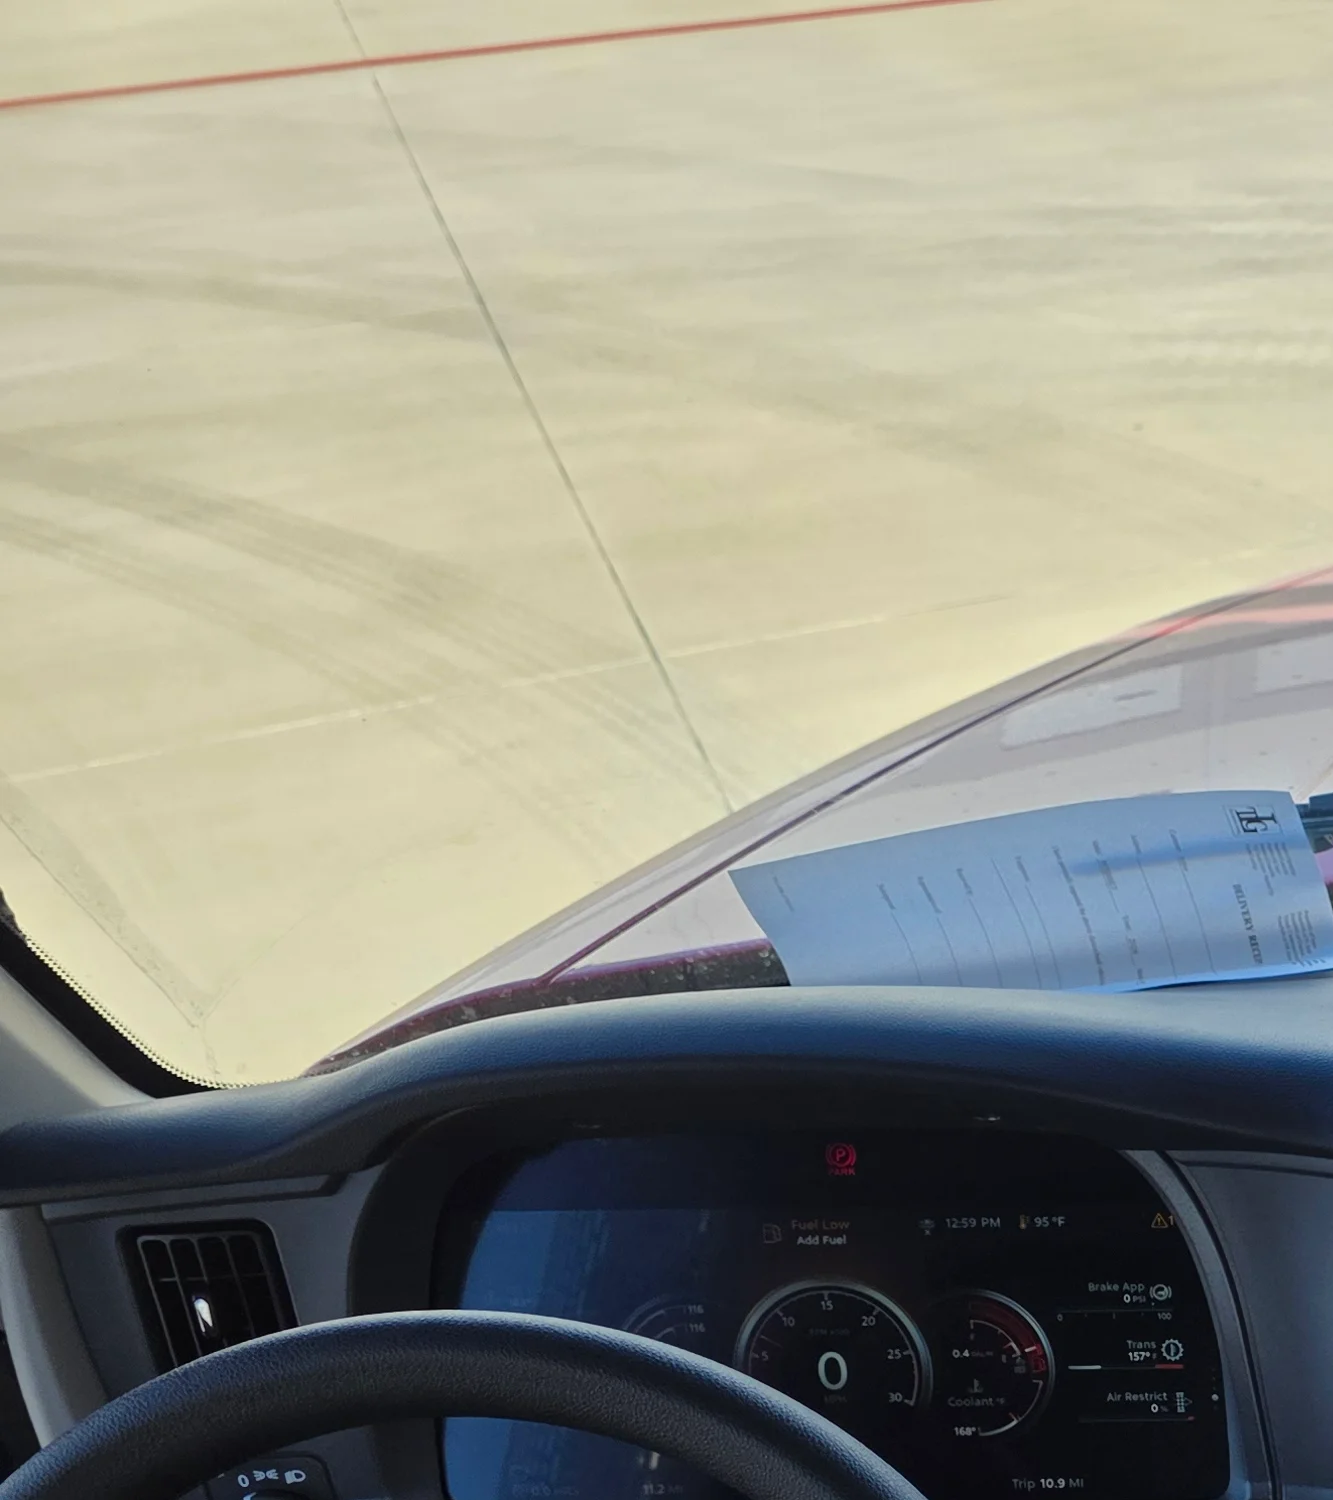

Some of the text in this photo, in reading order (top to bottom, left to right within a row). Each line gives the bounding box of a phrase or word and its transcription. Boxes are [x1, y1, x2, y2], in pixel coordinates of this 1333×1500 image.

[791, 1219, 850, 1231] Fuel Low
[945, 1217, 1001, 1229] 12:59 PM
[1034, 1217, 1049, 1228] 95
[797, 1235, 847, 1246] Add Fuel
[1088, 1282, 1145, 1294] Brake App
[1123, 1293, 1131, 1304] 0
[821, 1301, 834, 1311] 15
[782, 1316, 796, 1327] 10
[861, 1316, 876, 1327] 20
[1157, 1312, 1172, 1321] 100
[1126, 1340, 1157, 1350] Trans
[761, 1351, 769, 1361] 5
[887, 1349, 902, 1360] 25
[952, 1349, 970, 1359] 0.4
[817, 1351, 848, 1391] 0
[888, 1392, 903, 1403] 30
[948, 1397, 994, 1407] Coolant
[1106, 1391, 1168, 1402] Air Restrict
[1150, 1403, 1159, 1413] 0
[1012, 1478, 1036, 1492] Trip
[1040, 1478, 1066, 1489] 10.9
